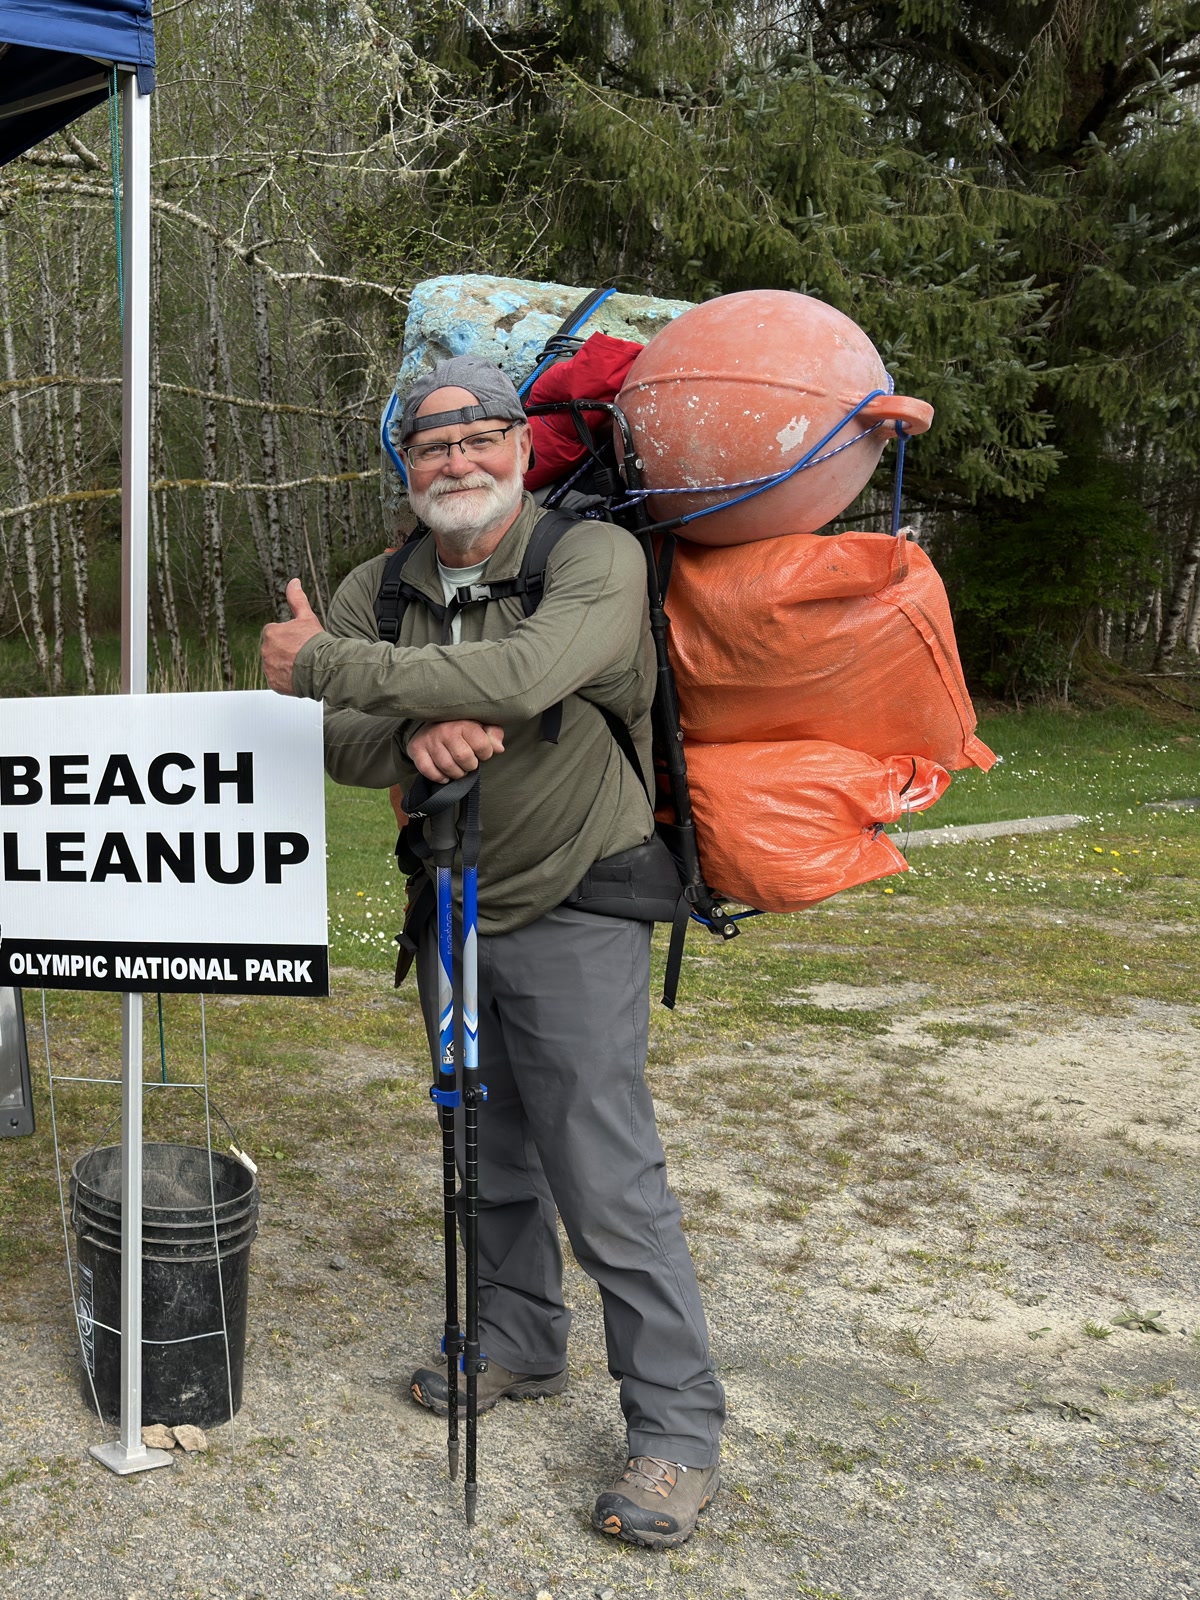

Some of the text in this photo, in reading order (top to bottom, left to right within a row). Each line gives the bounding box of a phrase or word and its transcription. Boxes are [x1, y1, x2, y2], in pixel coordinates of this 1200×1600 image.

[0, 751, 254, 806] BEACH
[9, 952, 313, 983] OLYMPIC NATIONAL PARK
